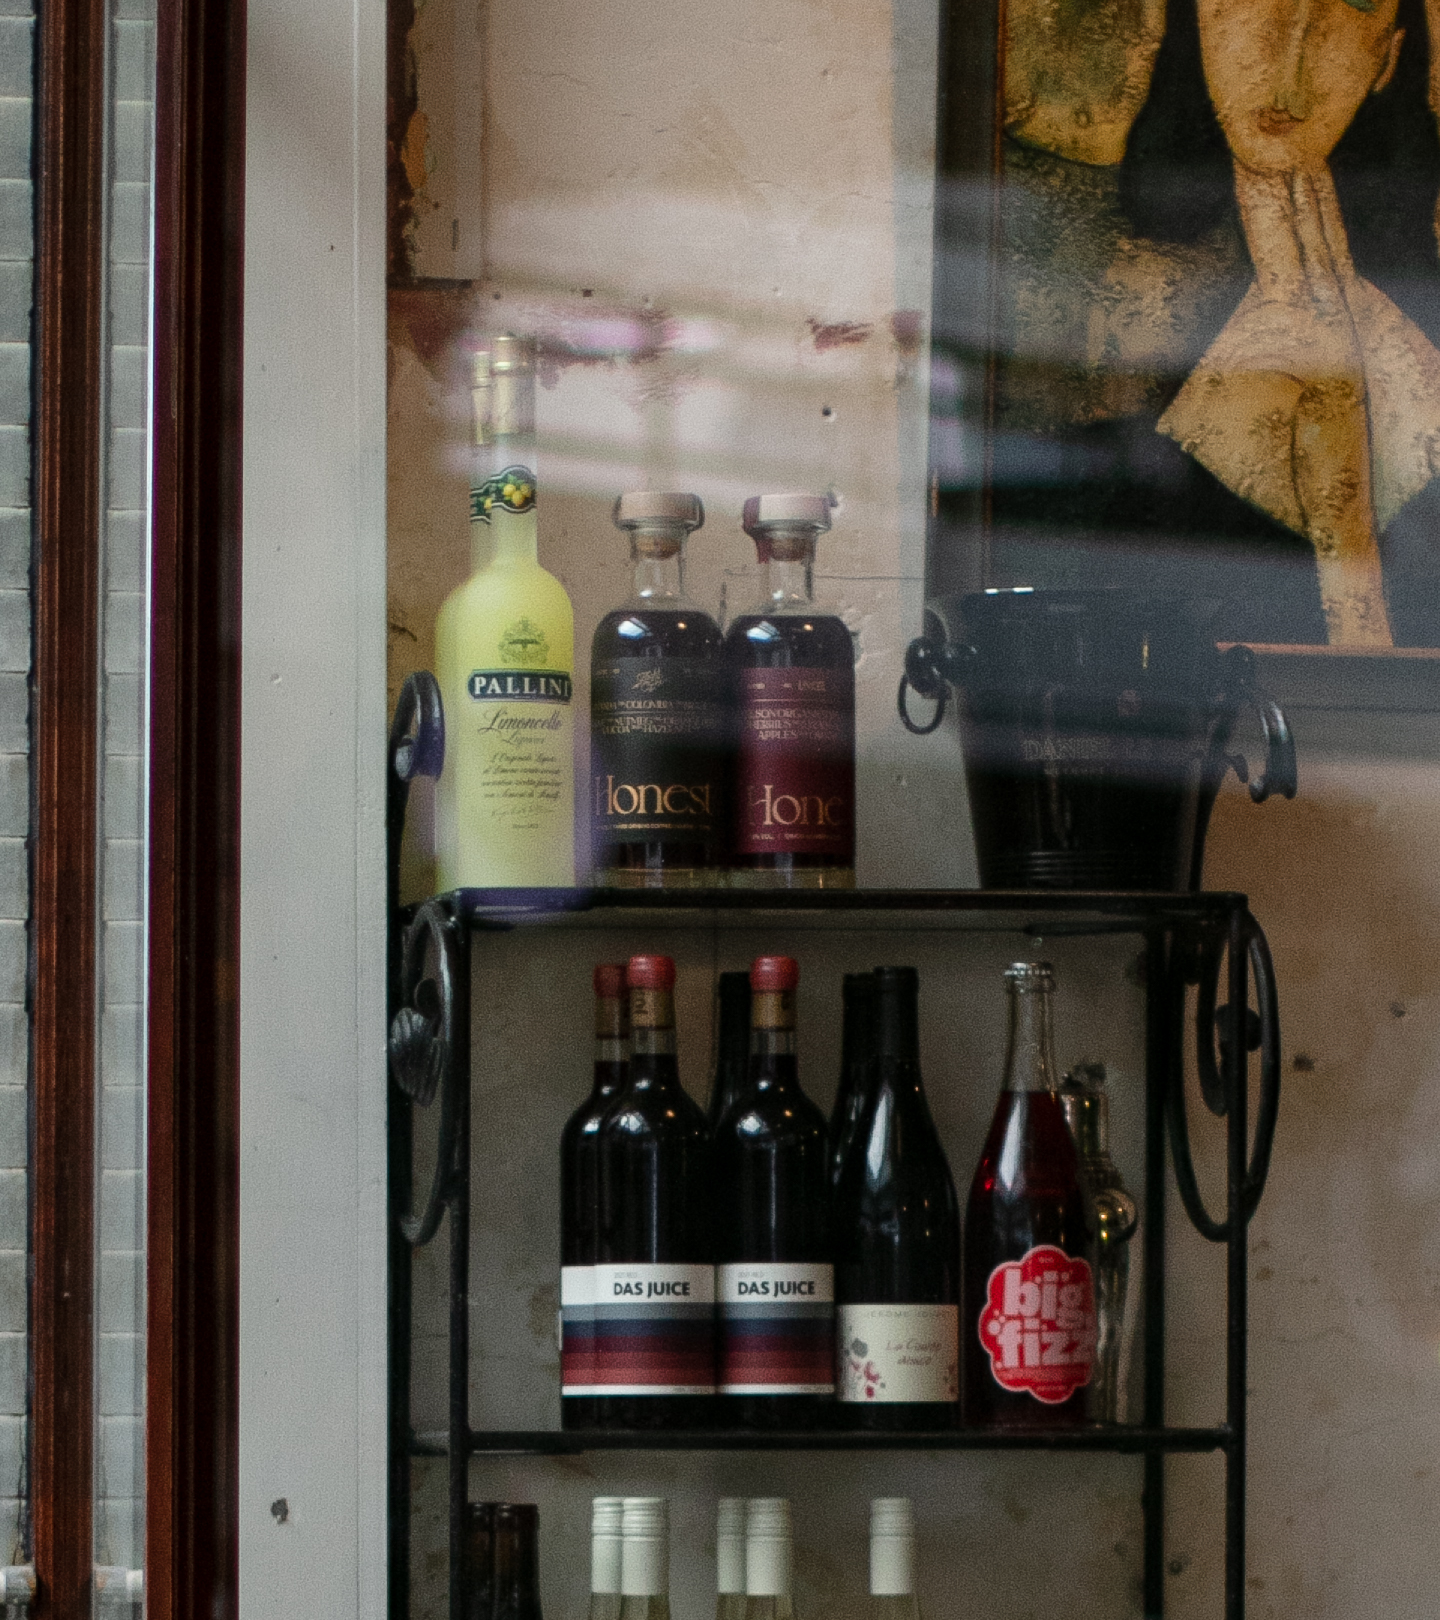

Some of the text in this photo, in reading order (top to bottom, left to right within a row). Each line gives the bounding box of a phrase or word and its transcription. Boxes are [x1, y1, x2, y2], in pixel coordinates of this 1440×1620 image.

[474, 676, 569, 697] PALLINI
[613, 1281, 691, 1298] DAS JUICE
[737, 1281, 816, 1298] DAS JUICE
[1003, 1268, 1085, 1329] big
[997, 1318, 1095, 1368] fizz
